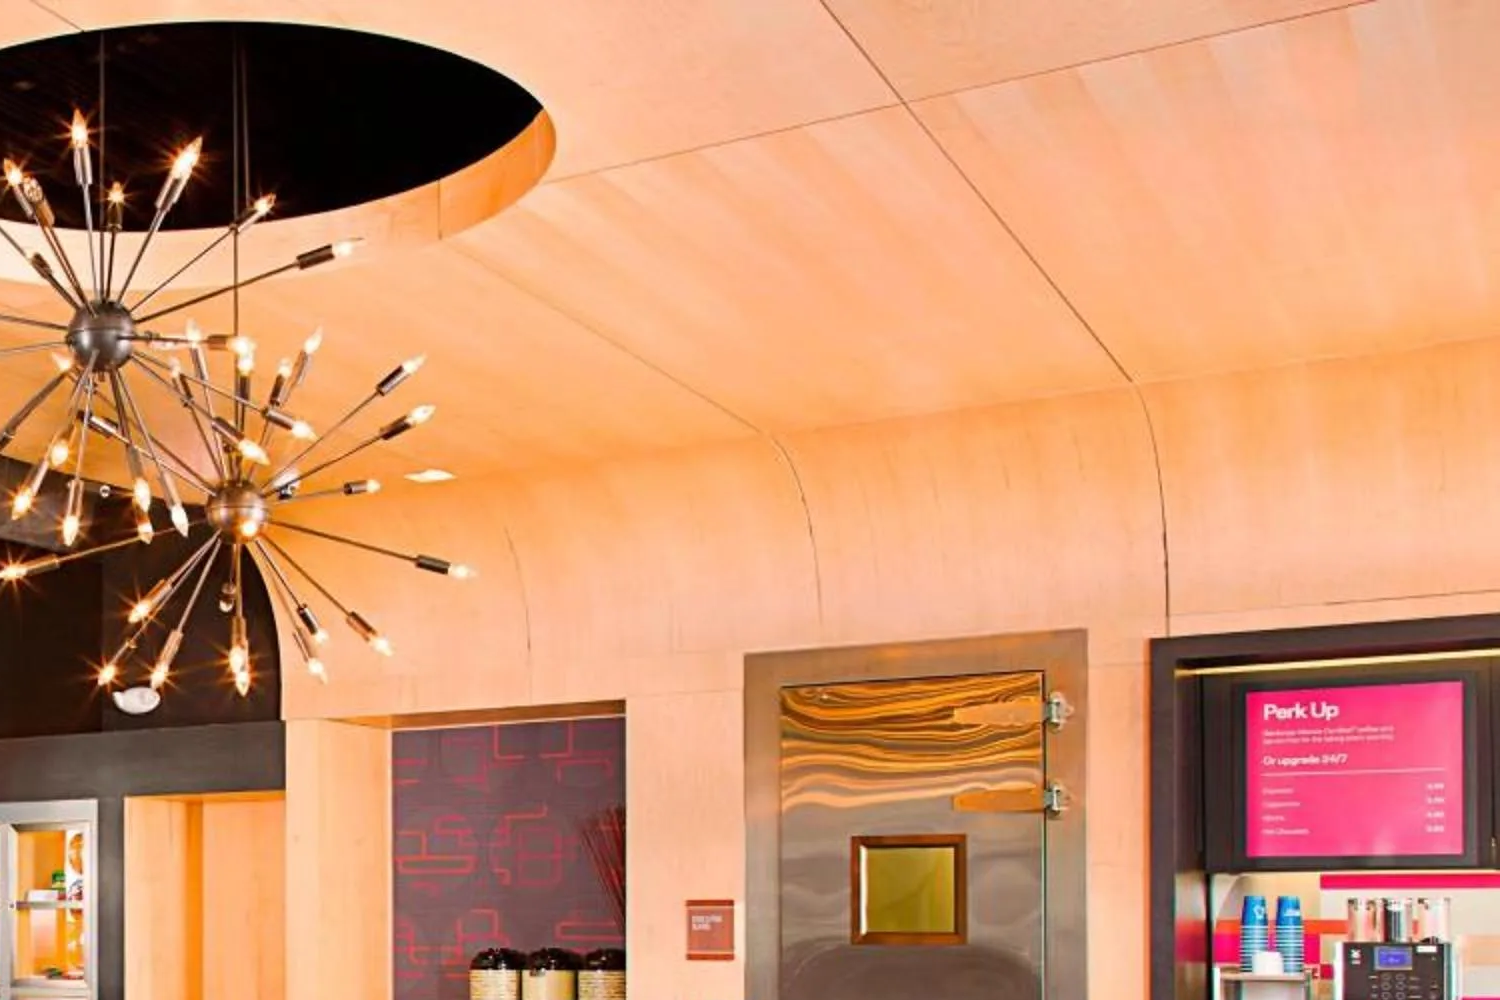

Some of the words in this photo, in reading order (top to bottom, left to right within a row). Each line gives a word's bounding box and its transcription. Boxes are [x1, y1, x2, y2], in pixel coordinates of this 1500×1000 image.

[1263, 701, 1308, 721] Perk
[1310, 700, 1340, 721] Up
[1262, 755, 1276, 766] Or
[1277, 754, 1320, 767] upgrade
[1321, 752, 1348, 764] 24/7
